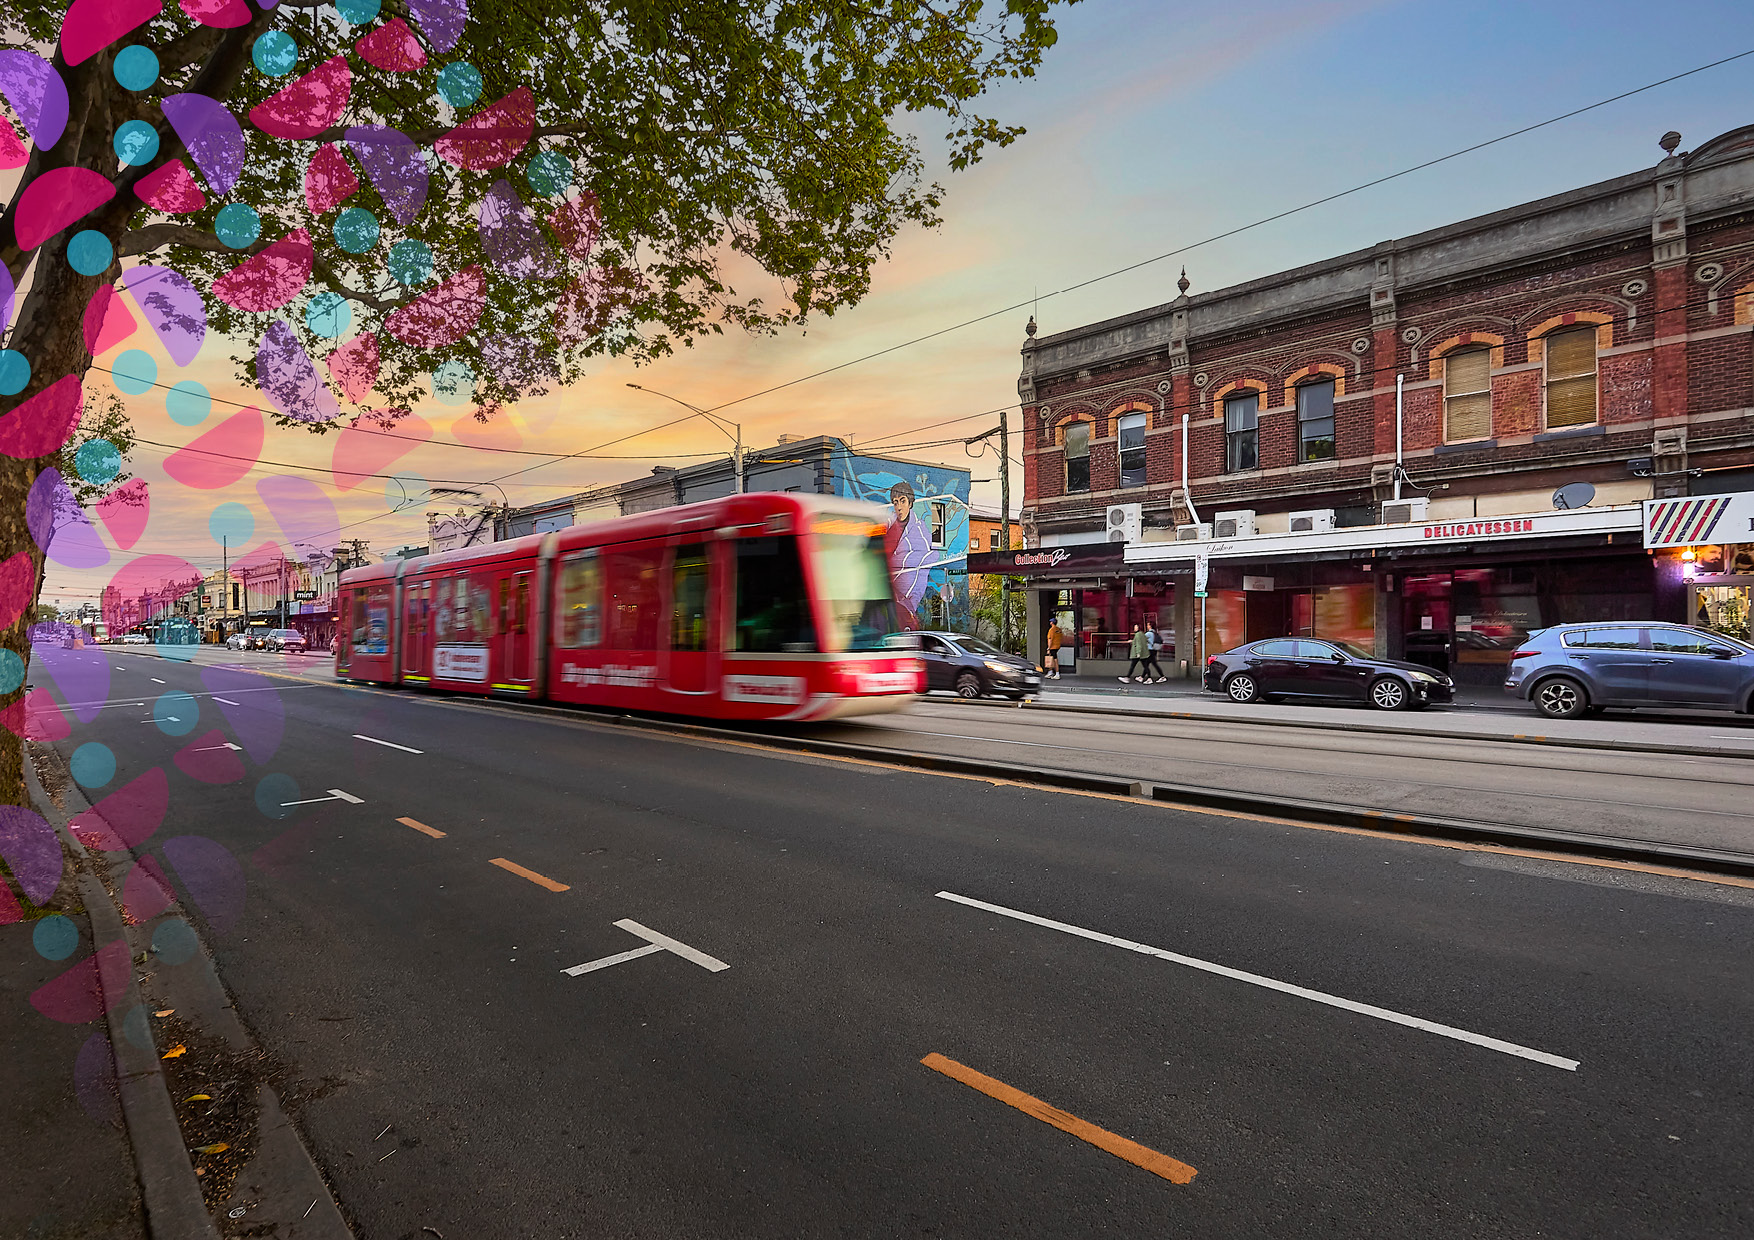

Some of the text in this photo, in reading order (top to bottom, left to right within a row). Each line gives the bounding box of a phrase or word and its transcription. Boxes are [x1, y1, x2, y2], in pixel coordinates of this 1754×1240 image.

[1424, 520, 1533, 538] DELICATESSEN
[1015, 548, 1071, 566] Collection Bar
[297, 589, 313, 598] mint
